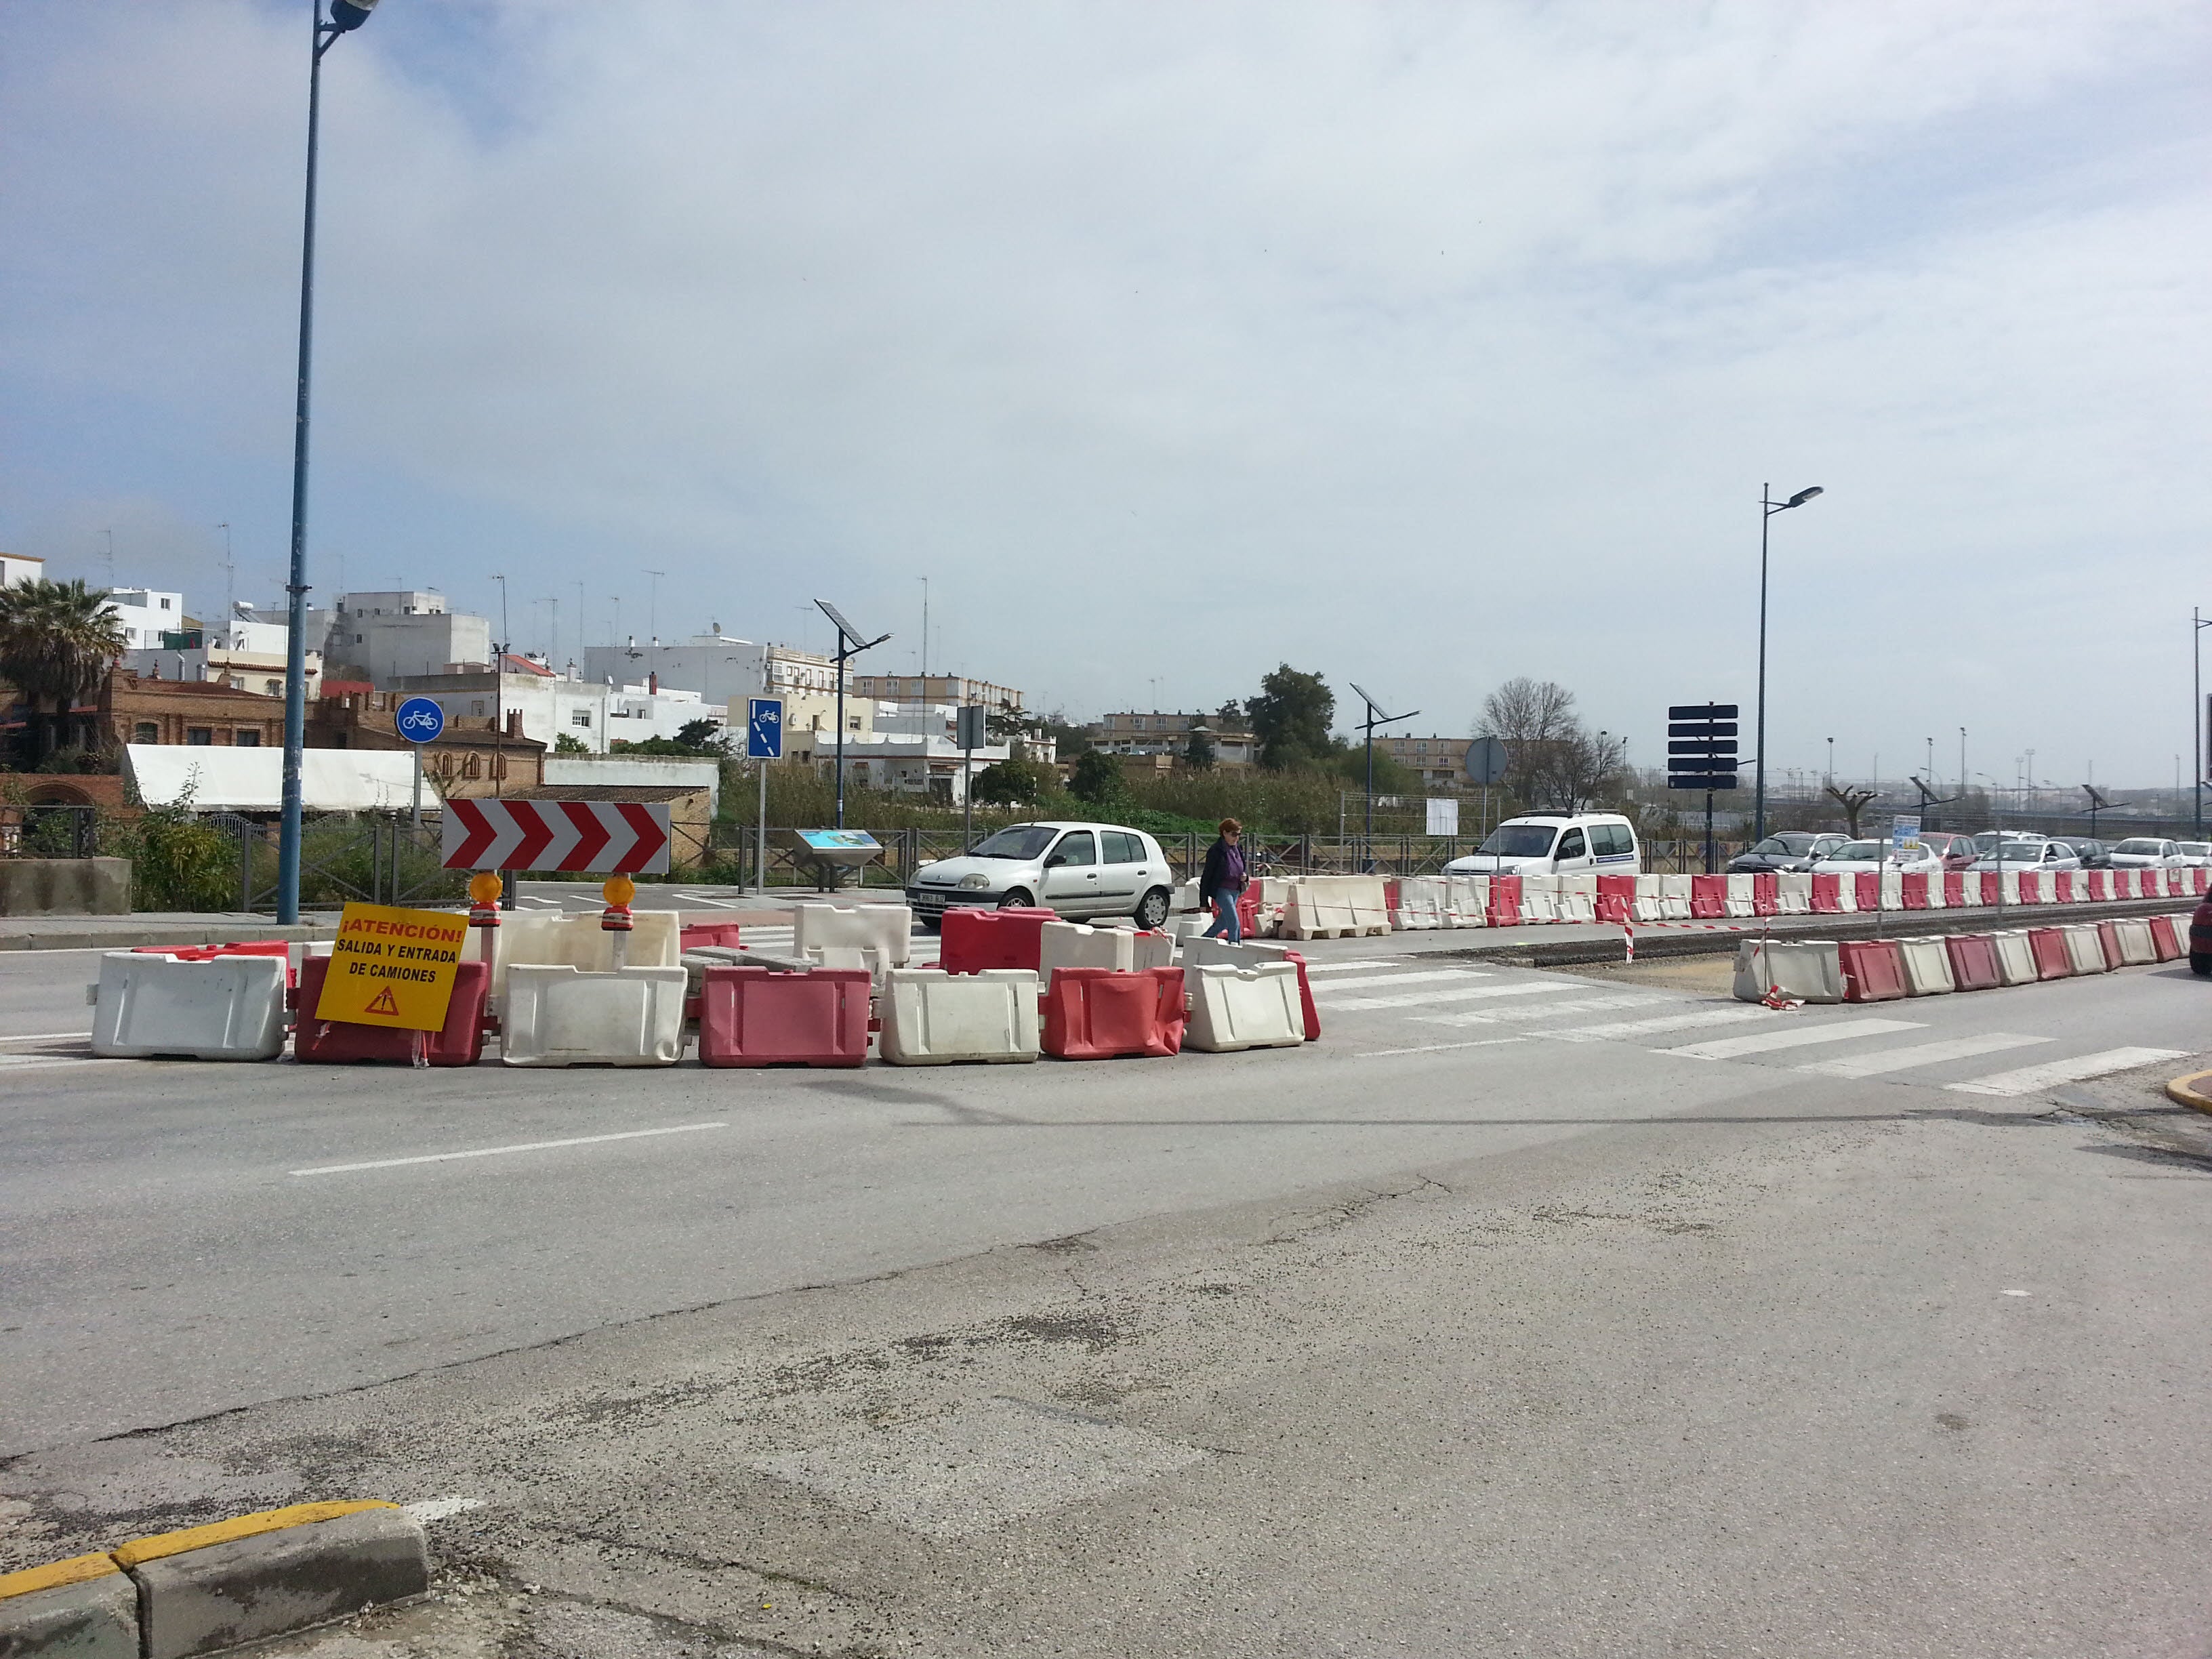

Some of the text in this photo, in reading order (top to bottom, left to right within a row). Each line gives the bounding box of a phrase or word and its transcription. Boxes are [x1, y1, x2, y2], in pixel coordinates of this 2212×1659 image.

[342, 918, 462, 942] ¡ATENCIÓN!
[337, 939, 455, 963] SALIDA Y ENTRADA
[349, 962, 436, 983] DE CAMIONES
